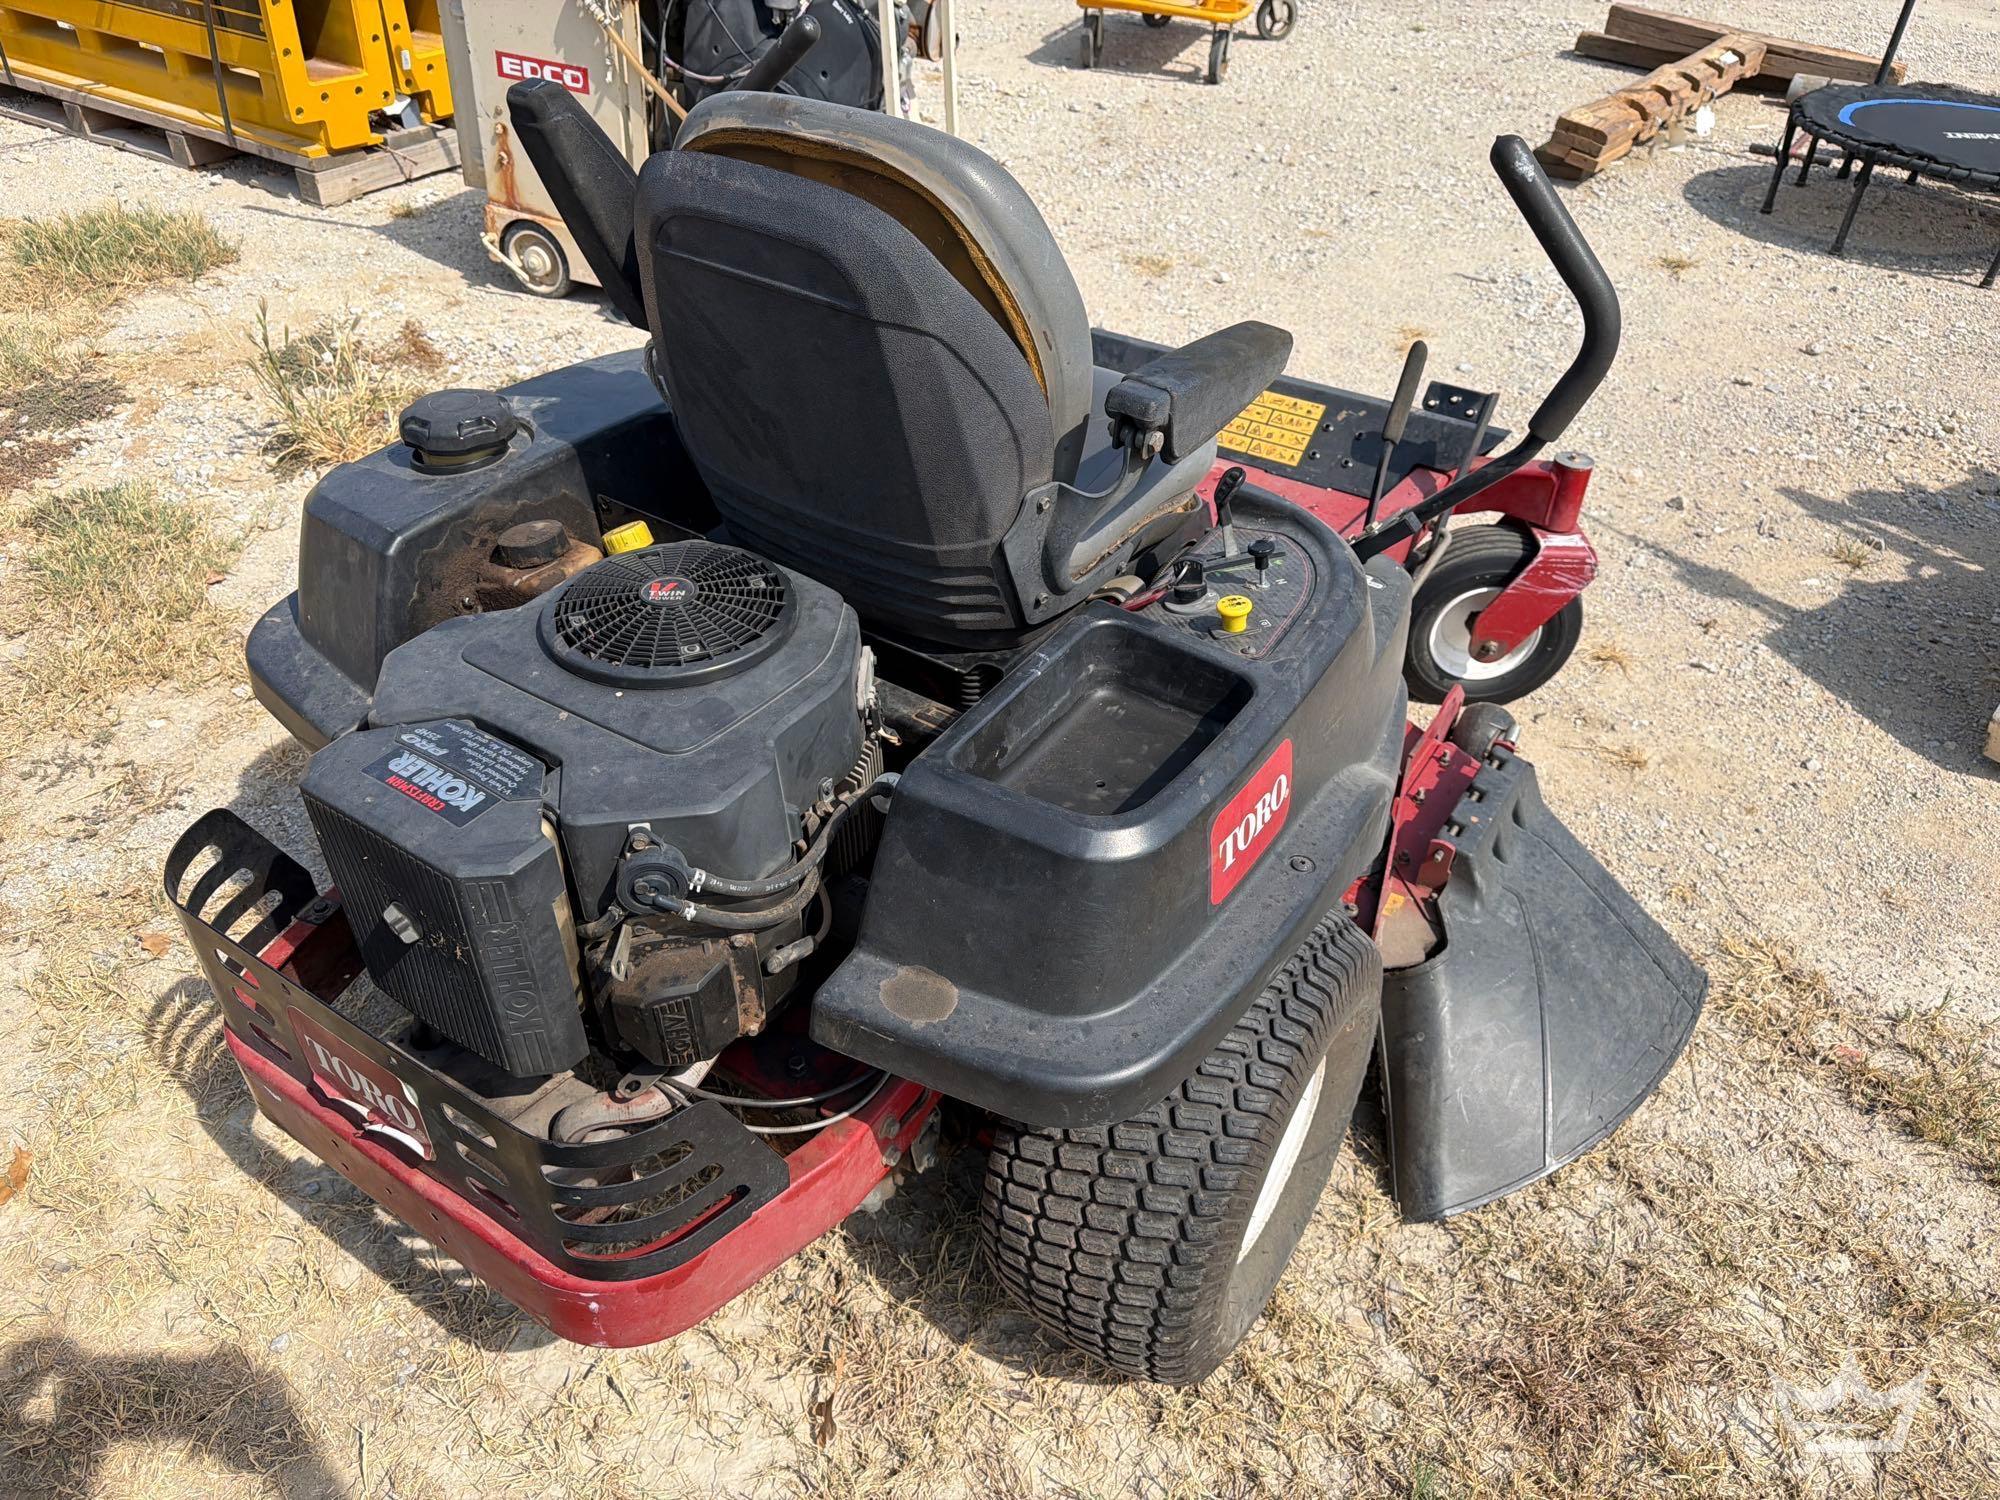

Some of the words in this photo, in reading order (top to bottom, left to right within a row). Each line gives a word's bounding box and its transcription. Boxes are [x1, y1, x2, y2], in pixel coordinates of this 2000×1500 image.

[501, 56, 584, 88] EDCO
[401, 733, 449, 757] PRO
[414, 728, 442, 742] 25HP
[386, 776, 445, 811] CRAFTSMAN
[387, 751, 487, 811] KOHLER
[1219, 773, 1288, 873] TORO
[482, 922, 546, 1035] KOHLER
[304, 1033, 417, 1130] TORO
